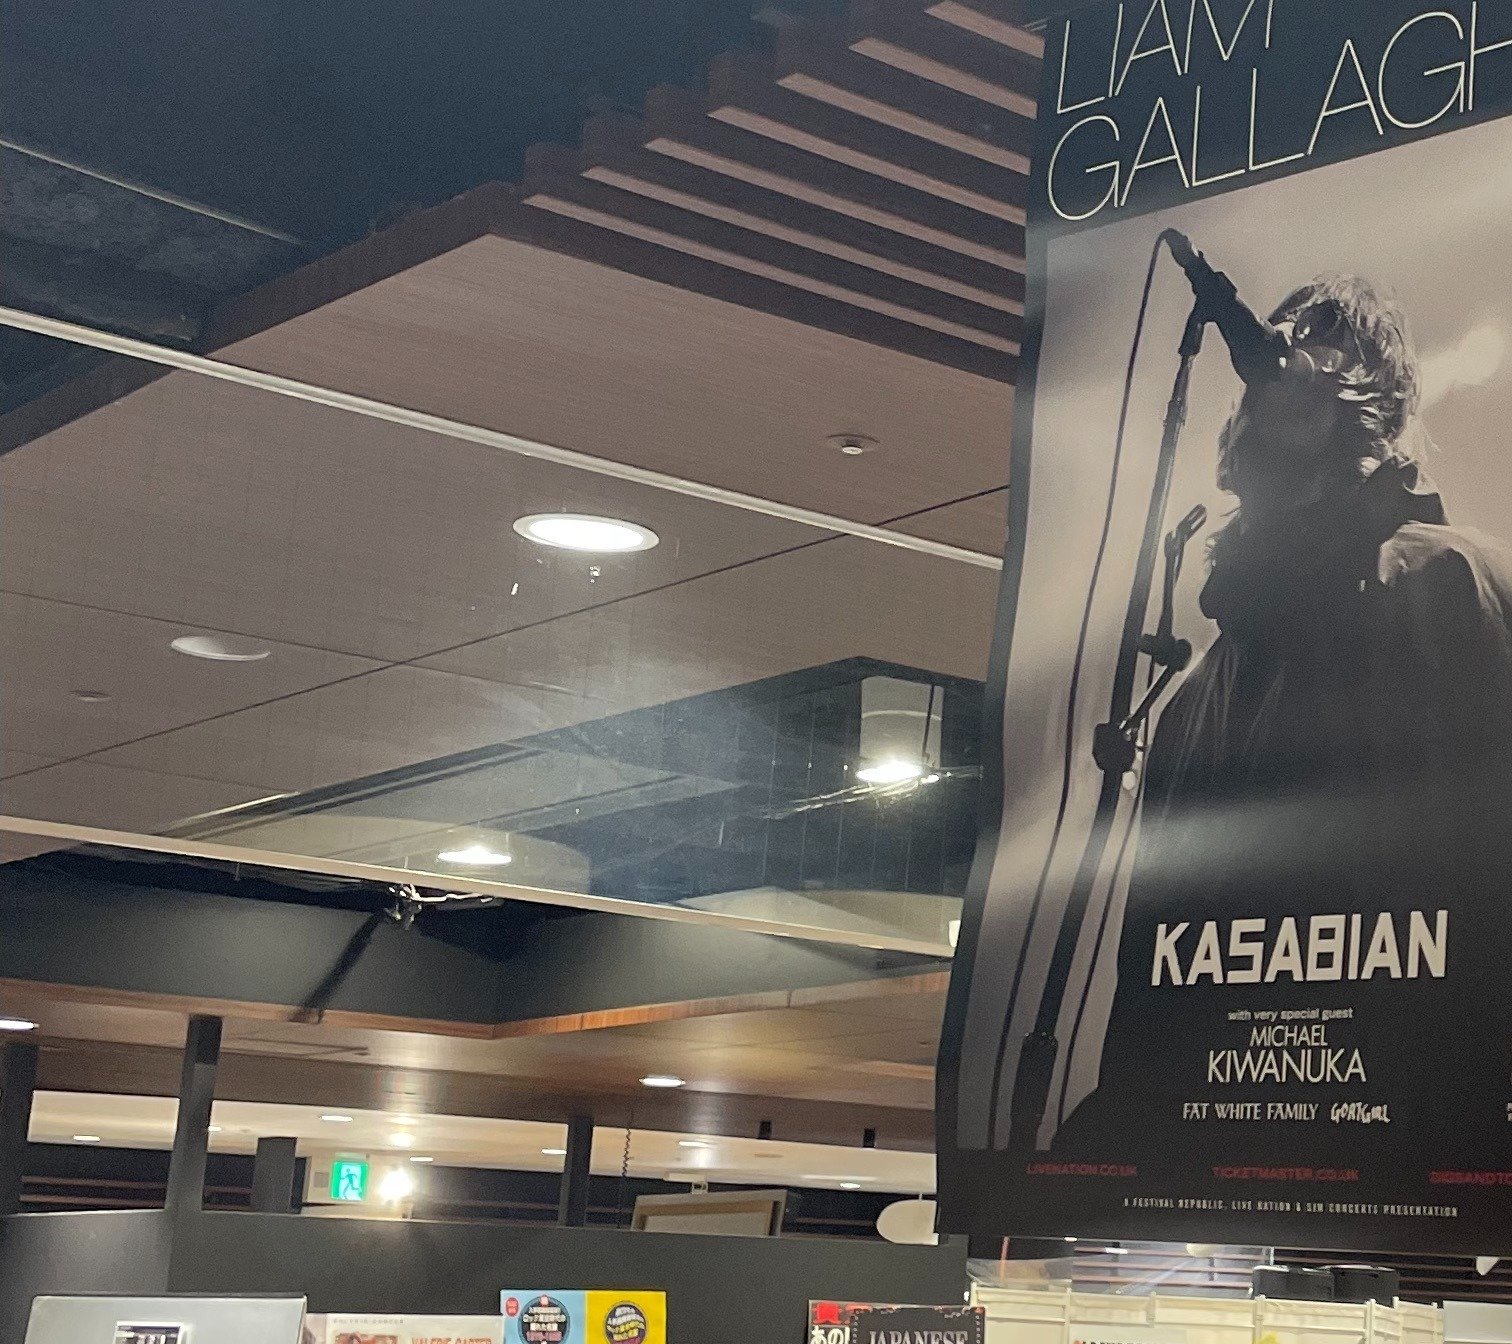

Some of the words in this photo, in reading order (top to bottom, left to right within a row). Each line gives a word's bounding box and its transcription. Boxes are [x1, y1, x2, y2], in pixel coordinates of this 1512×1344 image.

[1150, 909, 1449, 986] KASABIAN
[1228, 1011, 1251, 1021] with
[1252, 1012, 1277, 1023] very
[1280, 1009, 1319, 1023] special
[1322, 1007, 1354, 1021] guest
[1250, 1024, 1328, 1047] MICHAEL
[1207, 1048, 1367, 1084] KIWANUKA
[1182, 1102, 1209, 1121] FAT
[1214, 1102, 1262, 1121] WHITE
[1266, 1102, 1319, 1121] FAMILY
[1383, 1205, 1458, 1217] PRESENTATION
